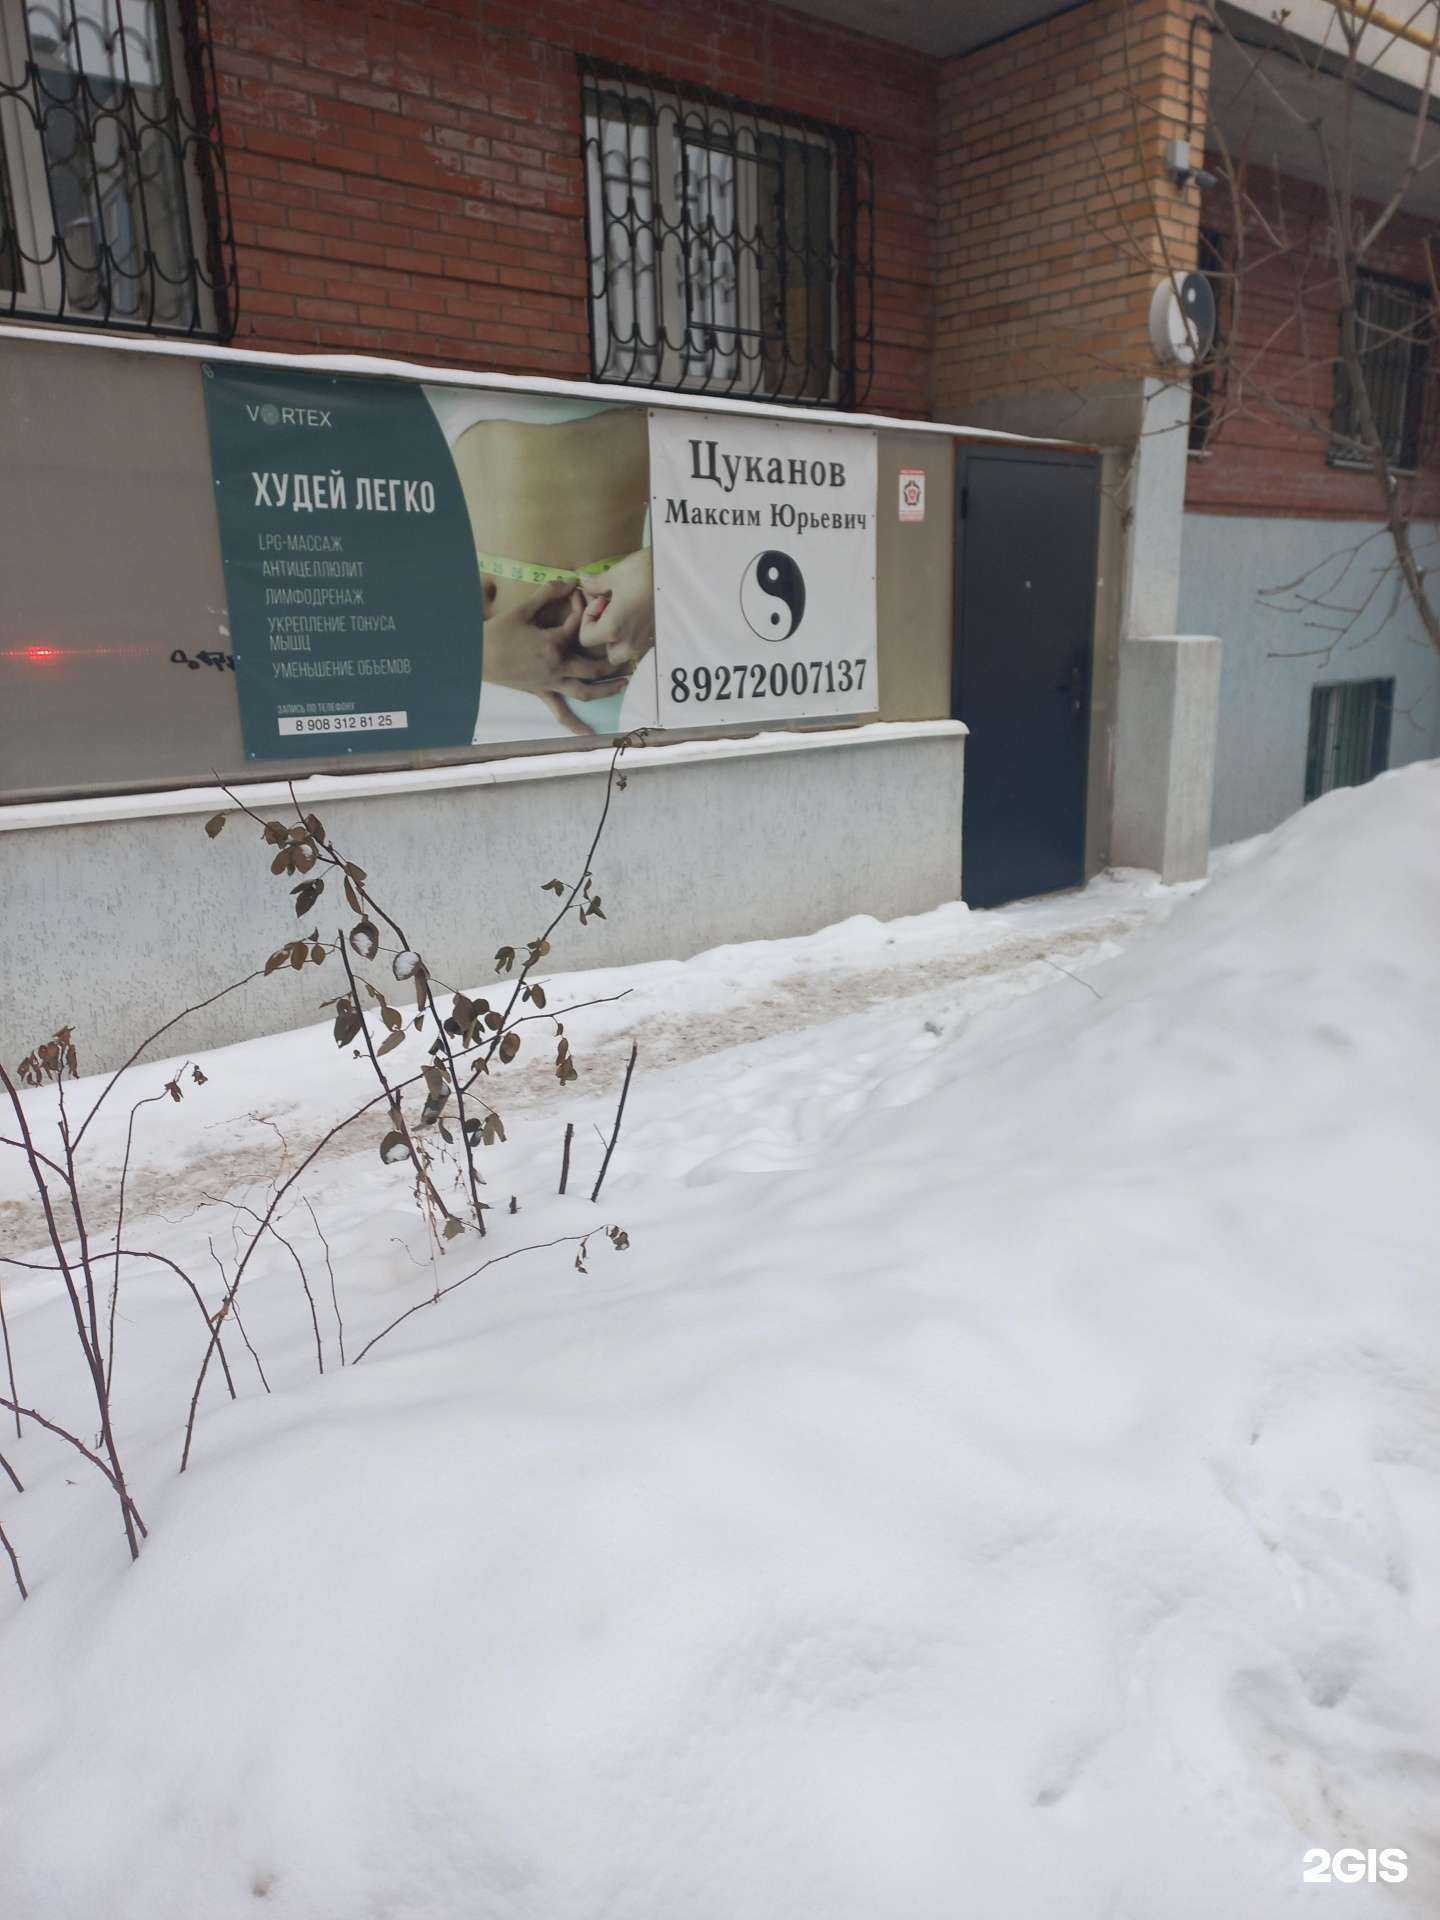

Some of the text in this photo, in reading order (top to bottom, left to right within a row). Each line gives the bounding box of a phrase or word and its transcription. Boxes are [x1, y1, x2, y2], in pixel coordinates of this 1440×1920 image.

[245, 404, 333, 428] VORTEX
[688, 439, 847, 492] Цуканов
[252, 468, 436, 514] ХУДЕЙ ЛЕГКО
[664, 497, 761, 527] Максим
[769, 503, 868, 535] Юрьевич
[258, 533, 344, 552] LPG-МАССАЖ
[262, 560, 365, 578] АНТИЦЕЛЛЮЛИТ
[265, 588, 365, 606] ЛИМФОДРЕНАЖ
[267, 615, 397, 633] УКРЕПЛЕНИЕ ТОНУСА
[269, 635, 311, 652] МЫШЦ
[272, 658, 412, 679] УМЕНЬШЕНИЕ ОБЪЕМОВ
[671, 658, 868, 704] 89272007137
[295, 714, 393, 731] 8 908 312 81 25
